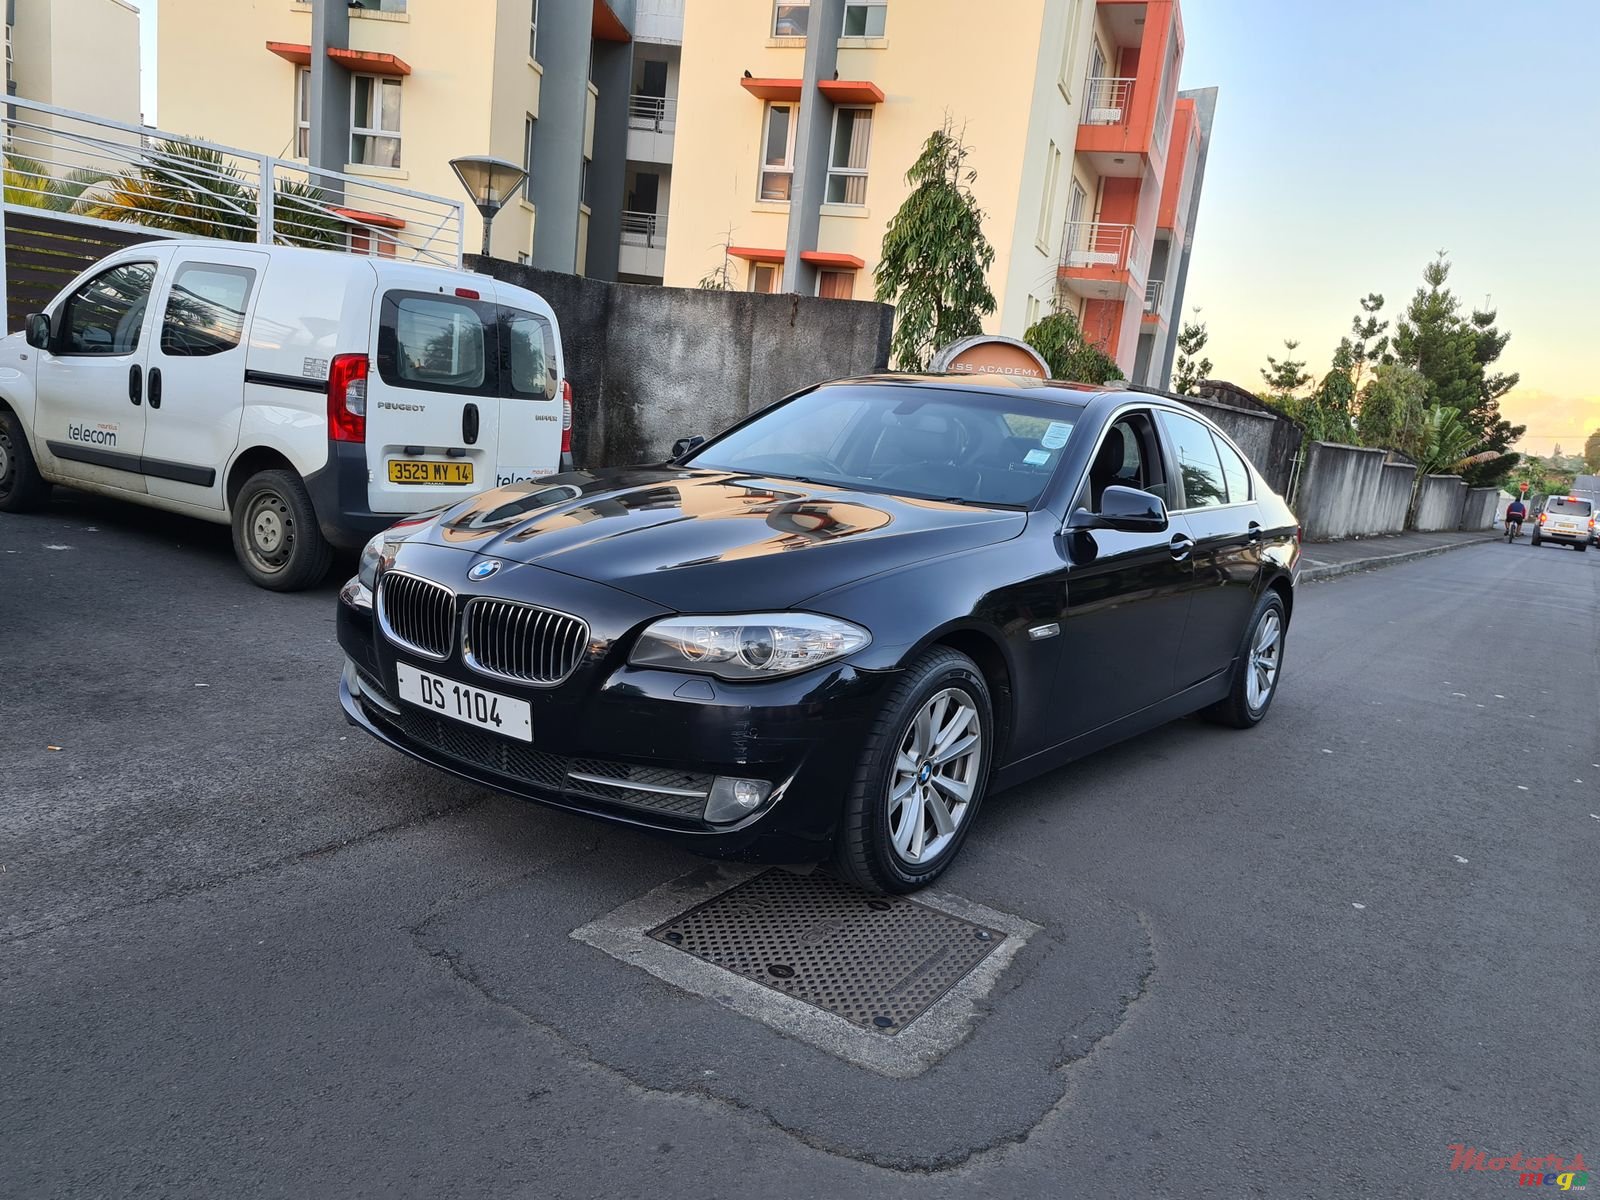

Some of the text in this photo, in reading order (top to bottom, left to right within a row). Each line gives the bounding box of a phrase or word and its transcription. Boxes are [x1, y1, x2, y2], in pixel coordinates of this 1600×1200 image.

[978, 365, 1039, 377] ACADEMY
[377, 401, 426, 412] PEUGEOT
[68, 423, 117, 447] telecom
[394, 463, 469, 481] 3529 MY 14
[420, 674, 503, 727] DS 1104
